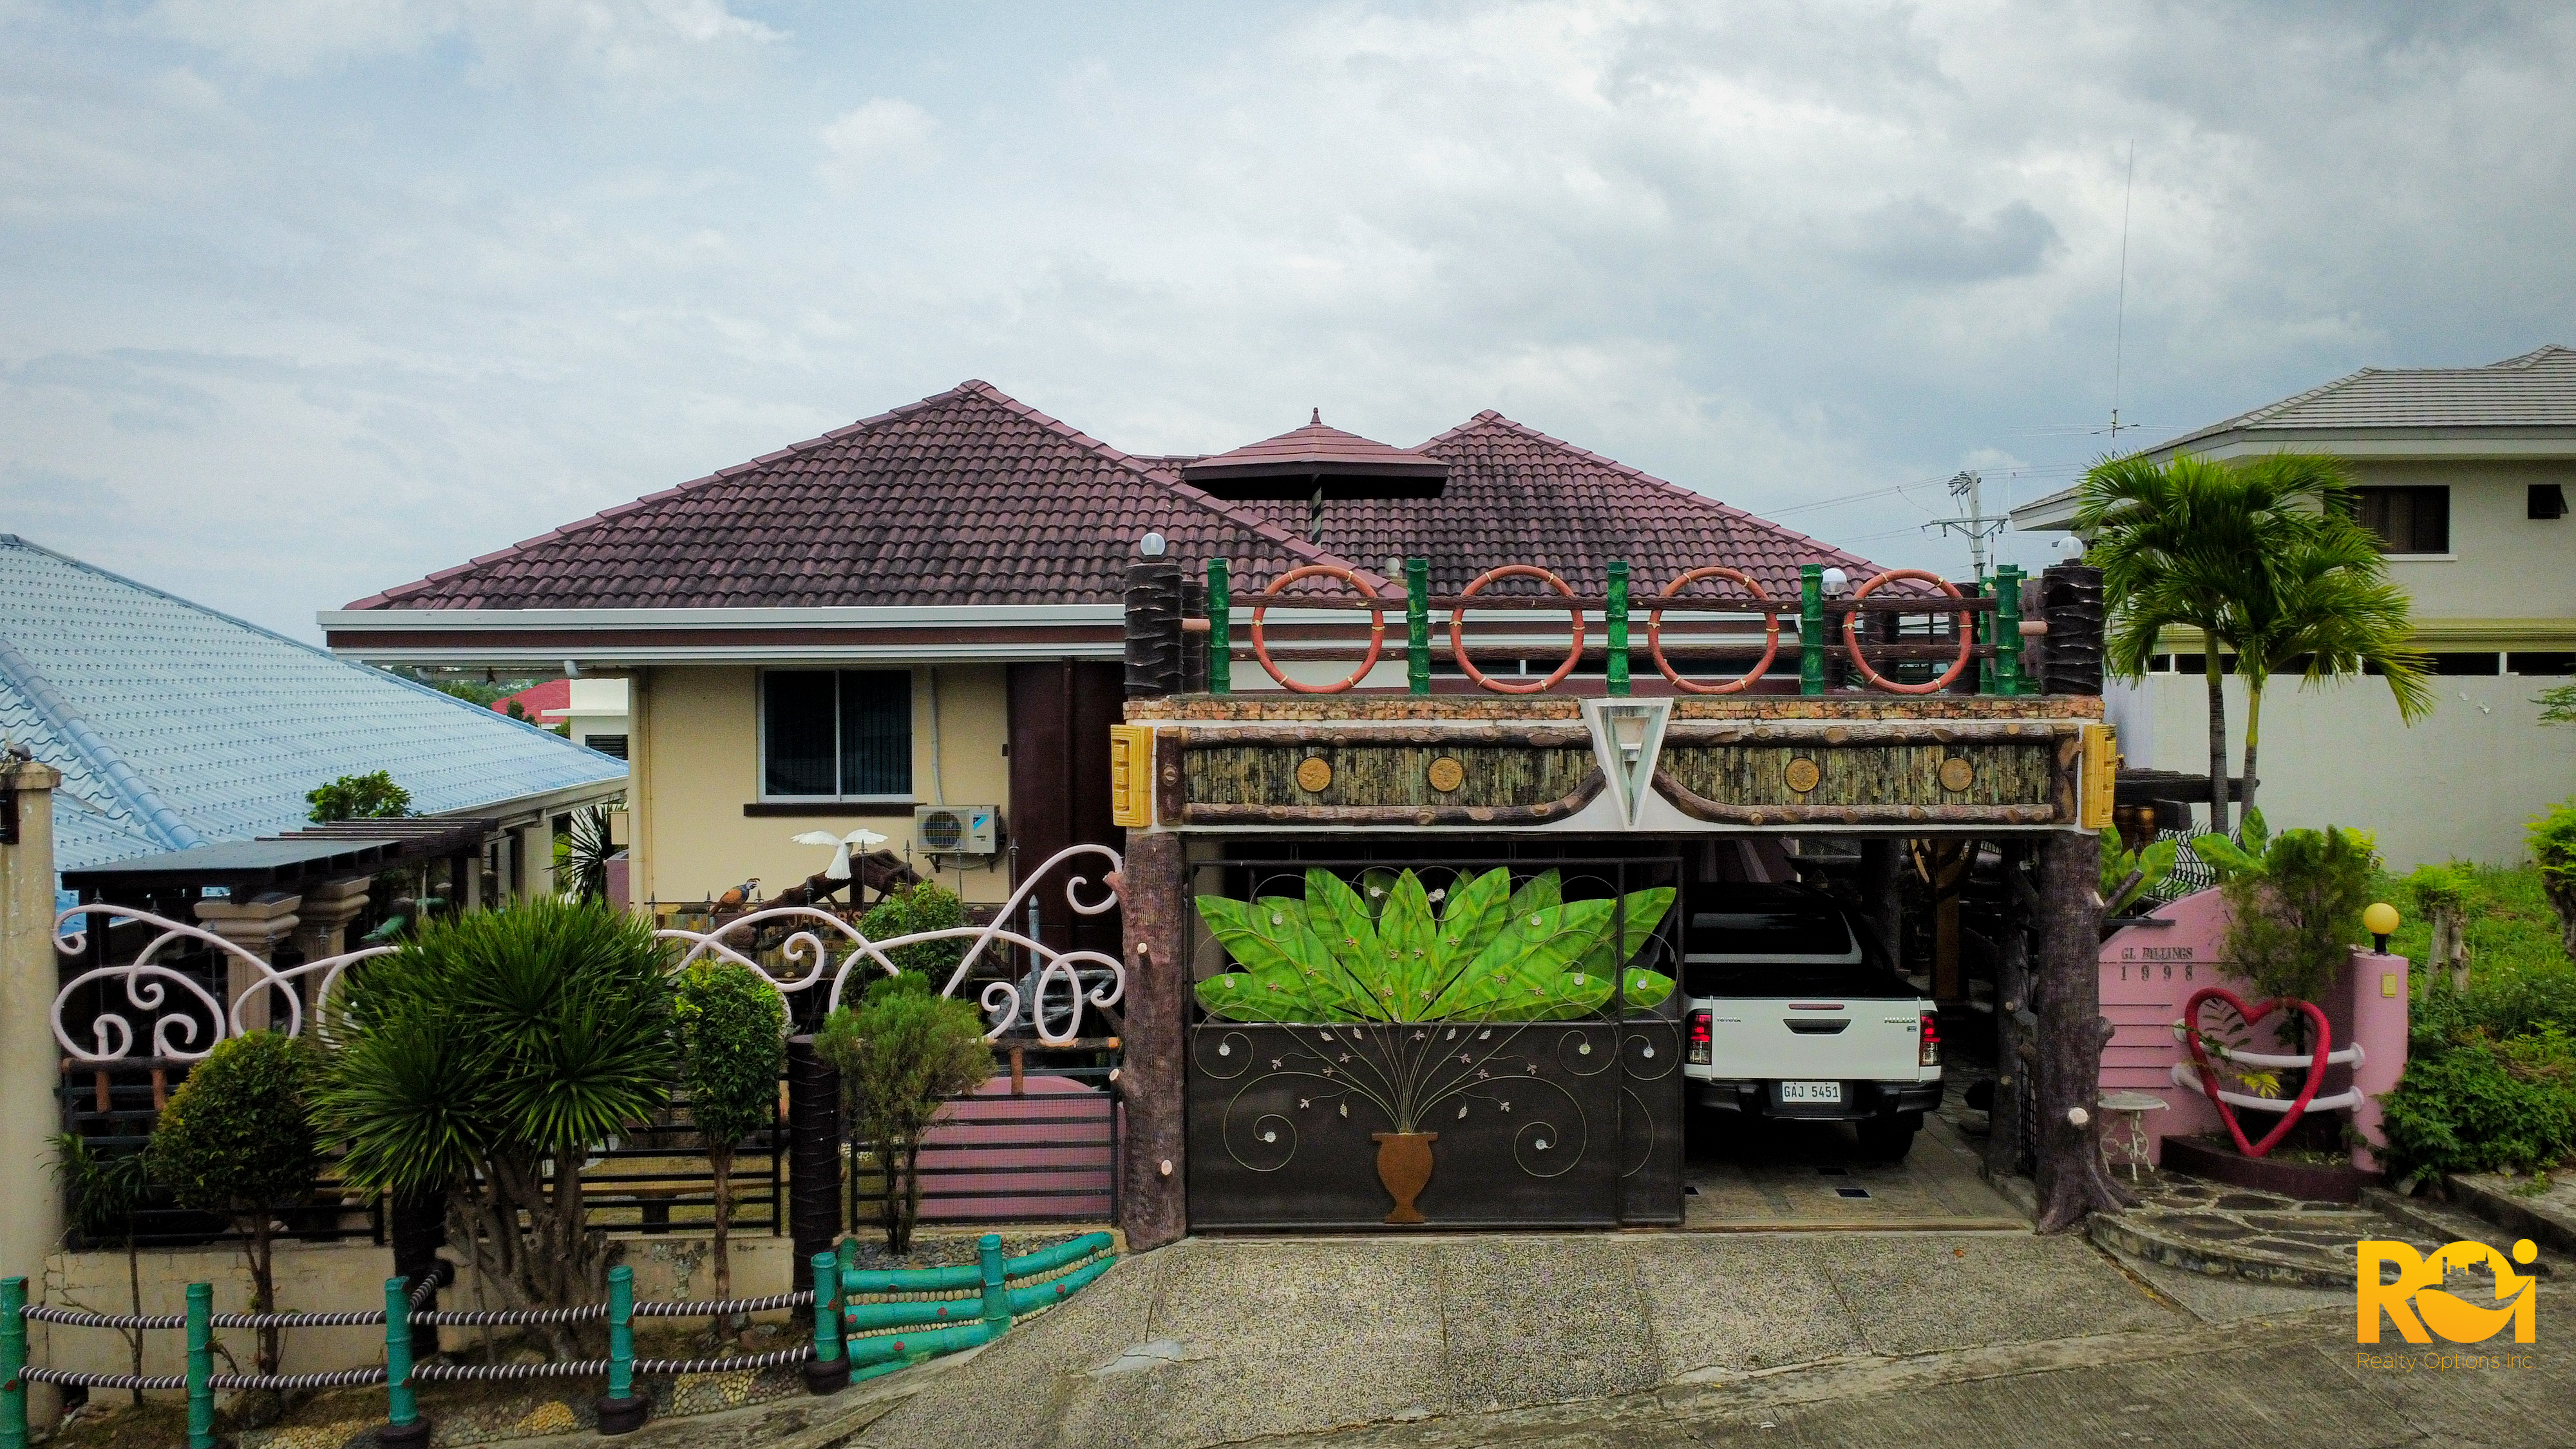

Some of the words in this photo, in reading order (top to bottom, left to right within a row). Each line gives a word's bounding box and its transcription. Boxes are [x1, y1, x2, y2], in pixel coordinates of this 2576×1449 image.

[2121, 947, 2136, 960] GL
[1784, 1086, 1804, 1097] GAJ
[1812, 1086, 1839, 1097] 5451
